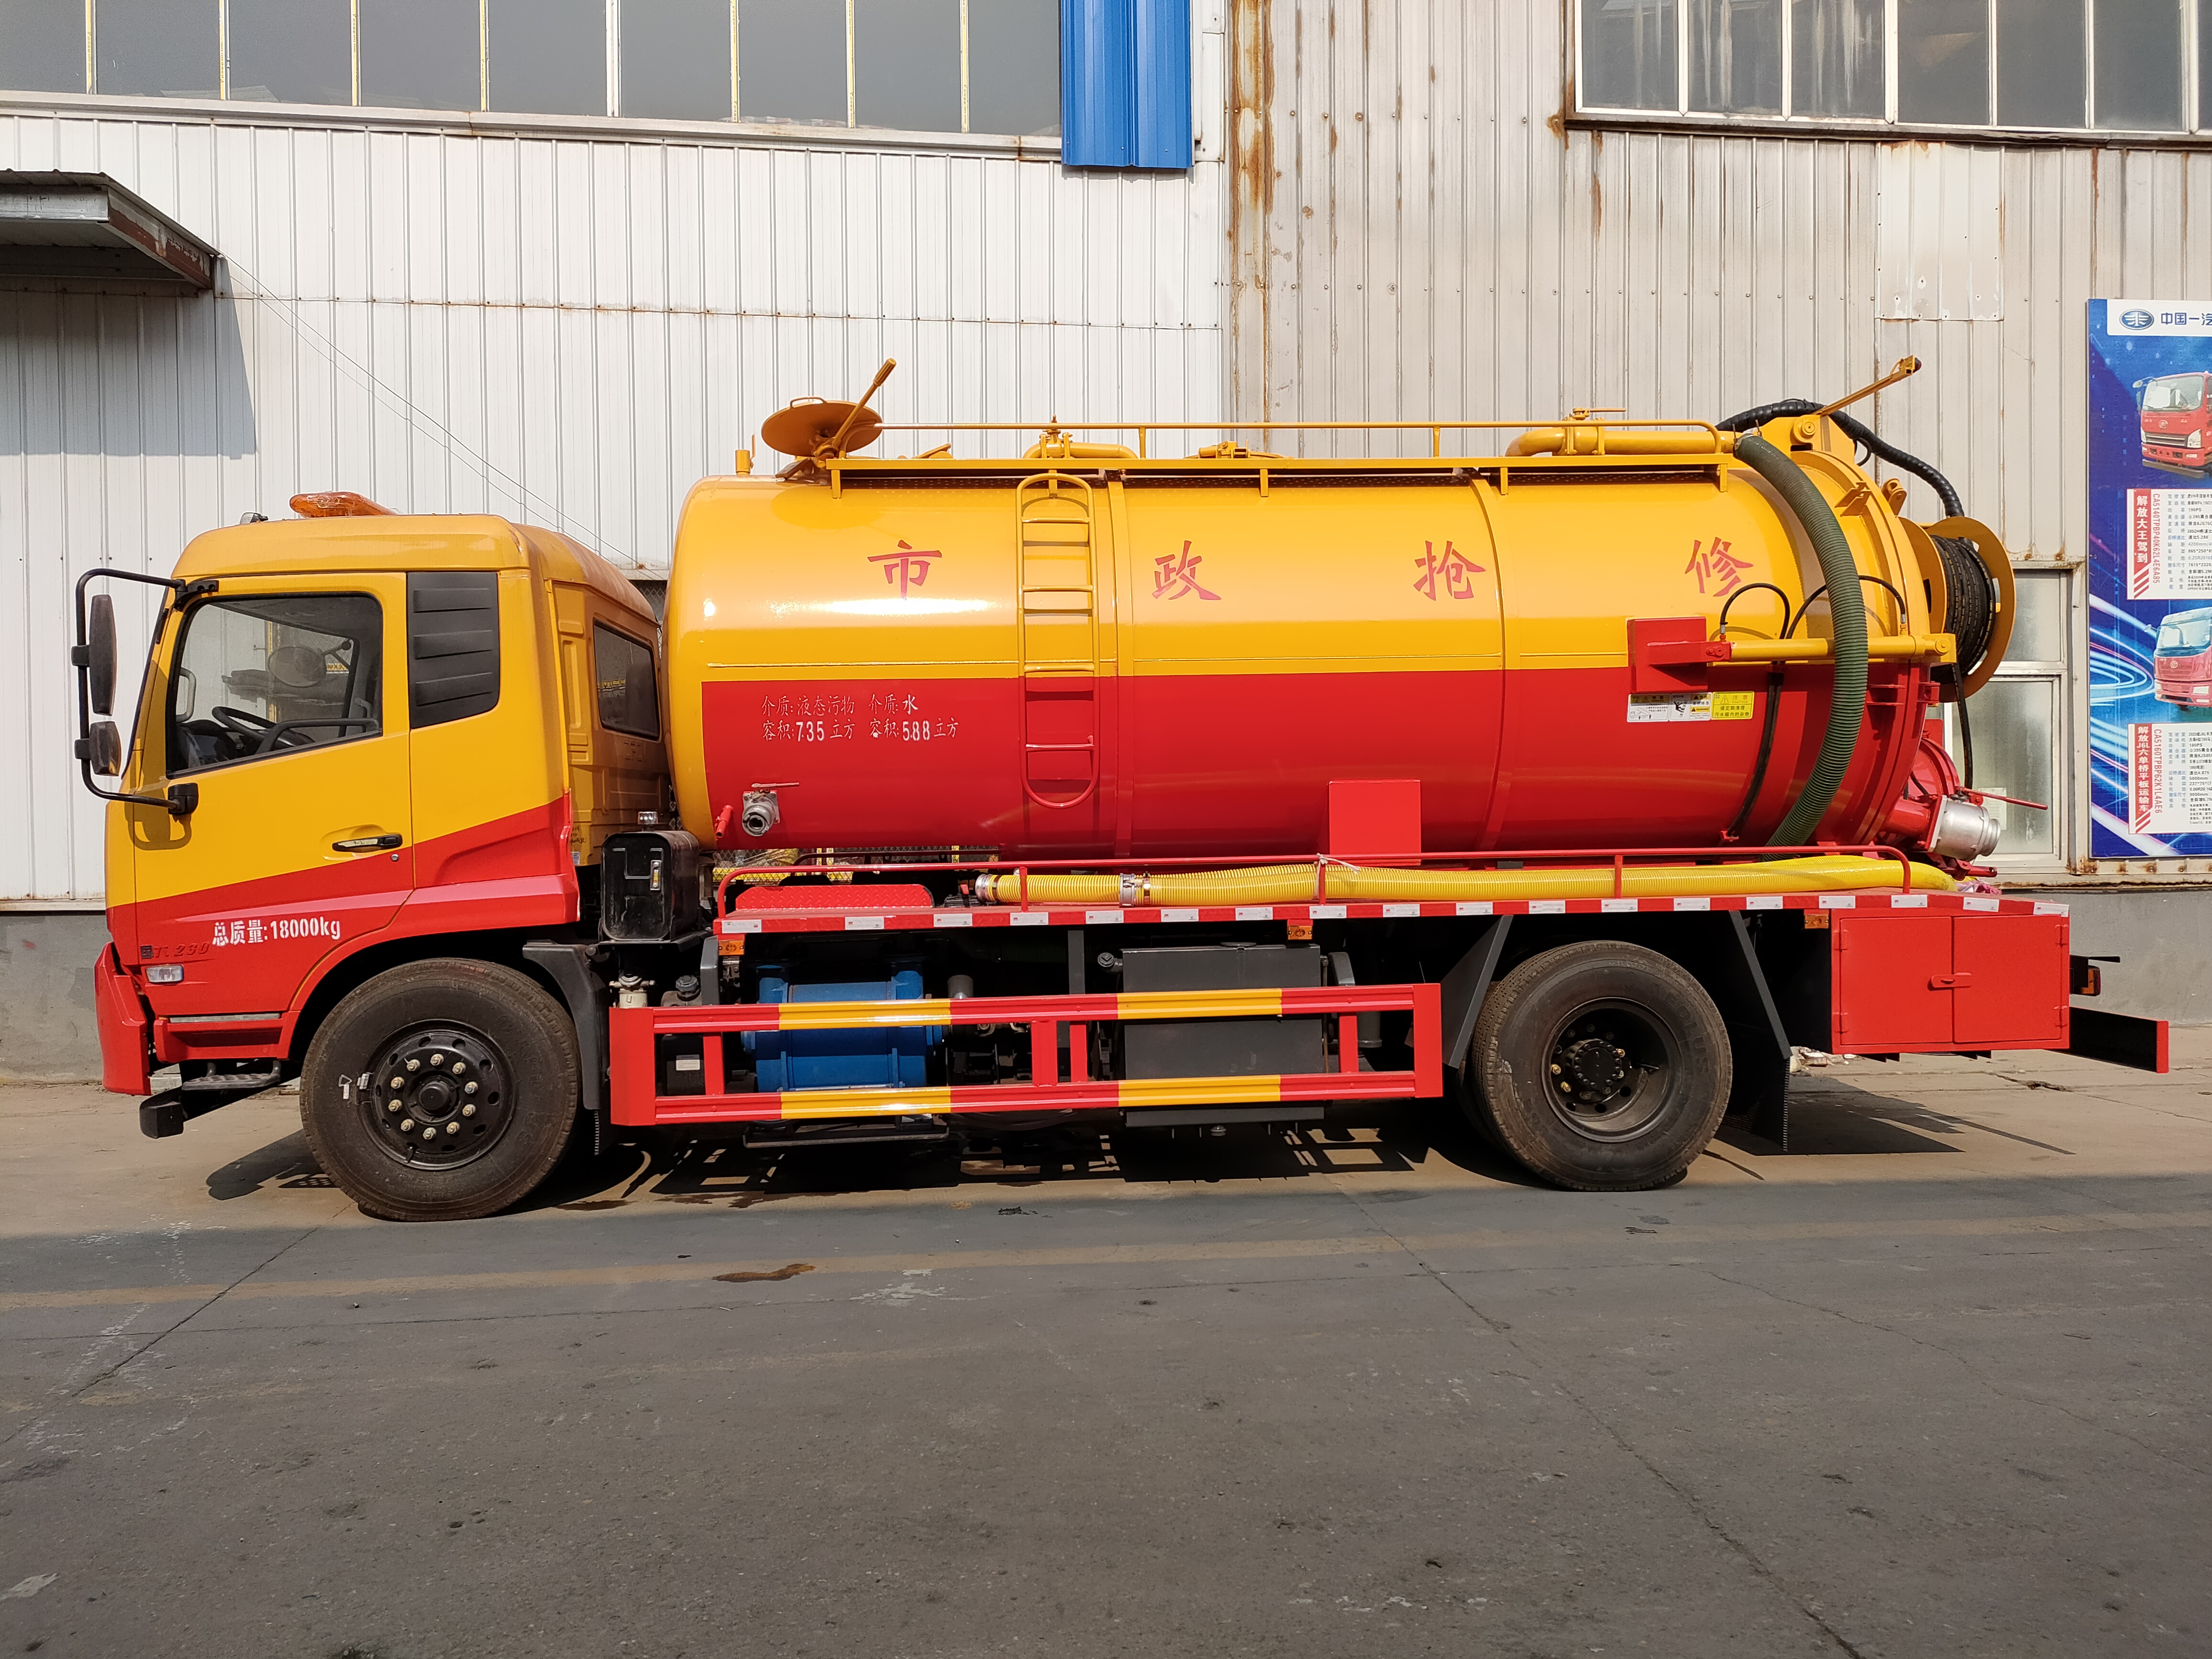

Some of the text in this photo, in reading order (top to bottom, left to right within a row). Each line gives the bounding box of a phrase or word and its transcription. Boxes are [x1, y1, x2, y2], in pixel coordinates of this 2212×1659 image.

[2136, 495, 2148, 563] 解放大王驾到
[867, 537, 1754, 601] 市 政 抢 修
[761, 694, 918, 717] 介质:液态污物 介质:水
[212, 917, 341, 947] 总质量:18000kg
